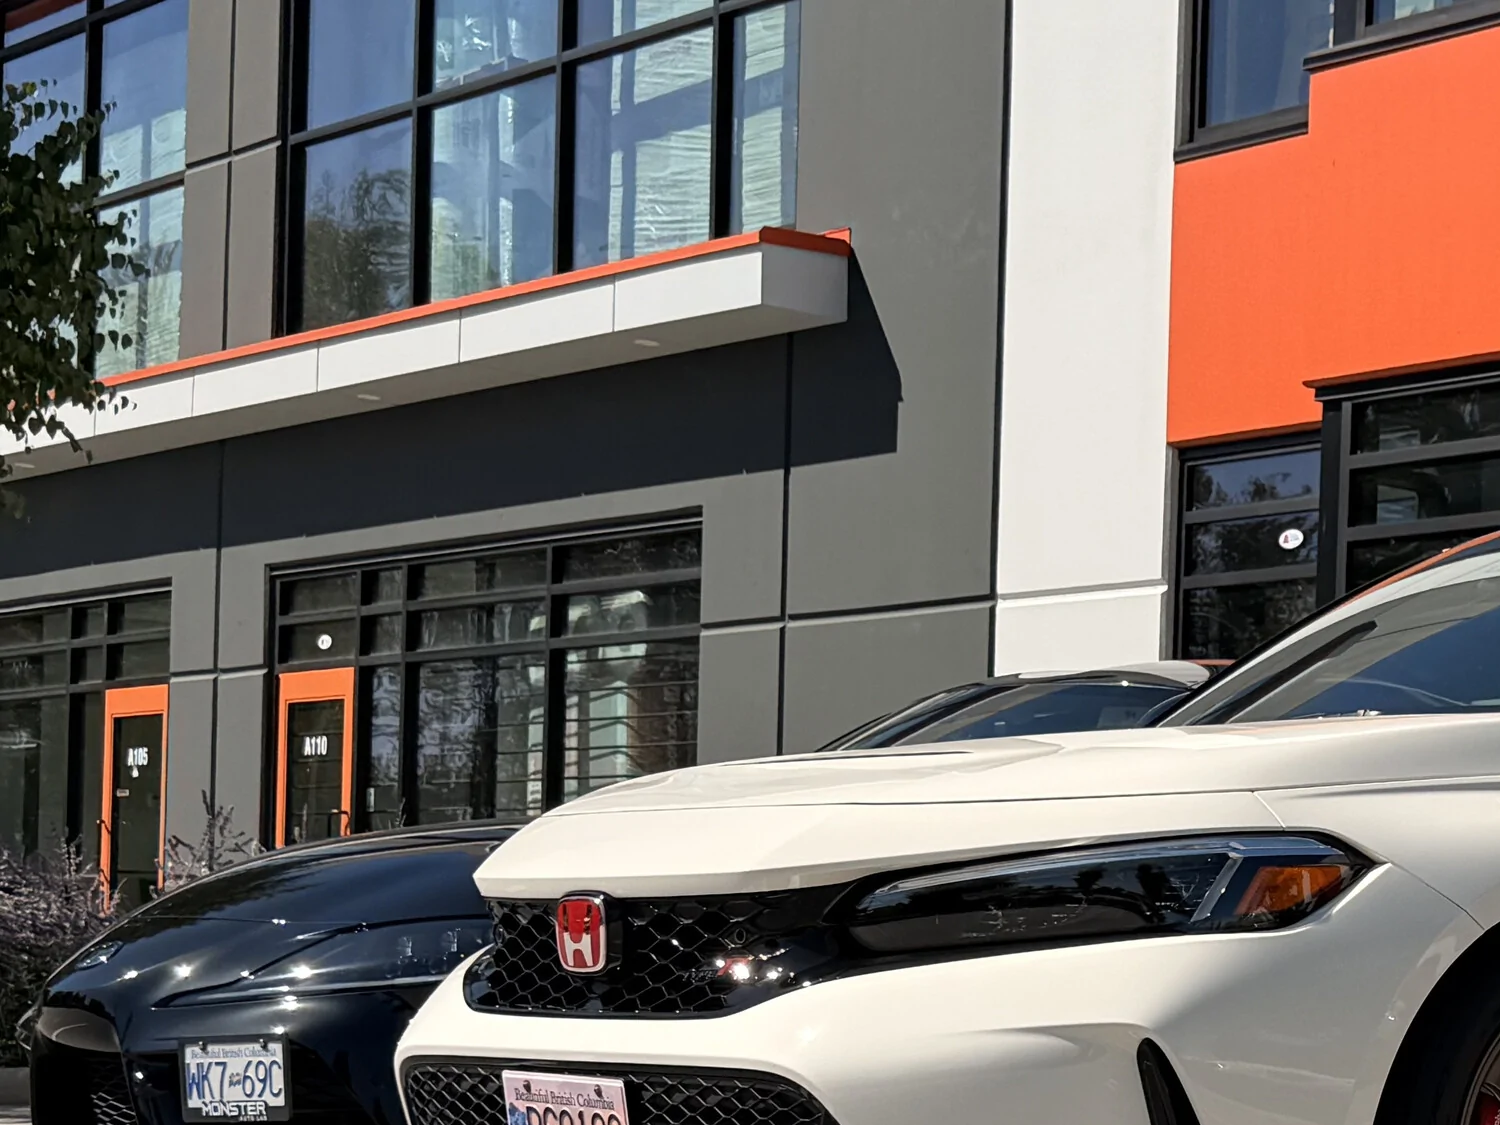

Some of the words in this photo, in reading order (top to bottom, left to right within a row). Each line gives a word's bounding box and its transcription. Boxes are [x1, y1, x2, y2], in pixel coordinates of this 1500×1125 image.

[304, 736, 328, 756] A110
[127, 747, 149, 766] A105
[186, 1060, 228, 1101] WK7
[241, 1059, 283, 1099] 69C
[550, 1091, 576, 1107] British
[202, 1101, 267, 1117] MONSTER
